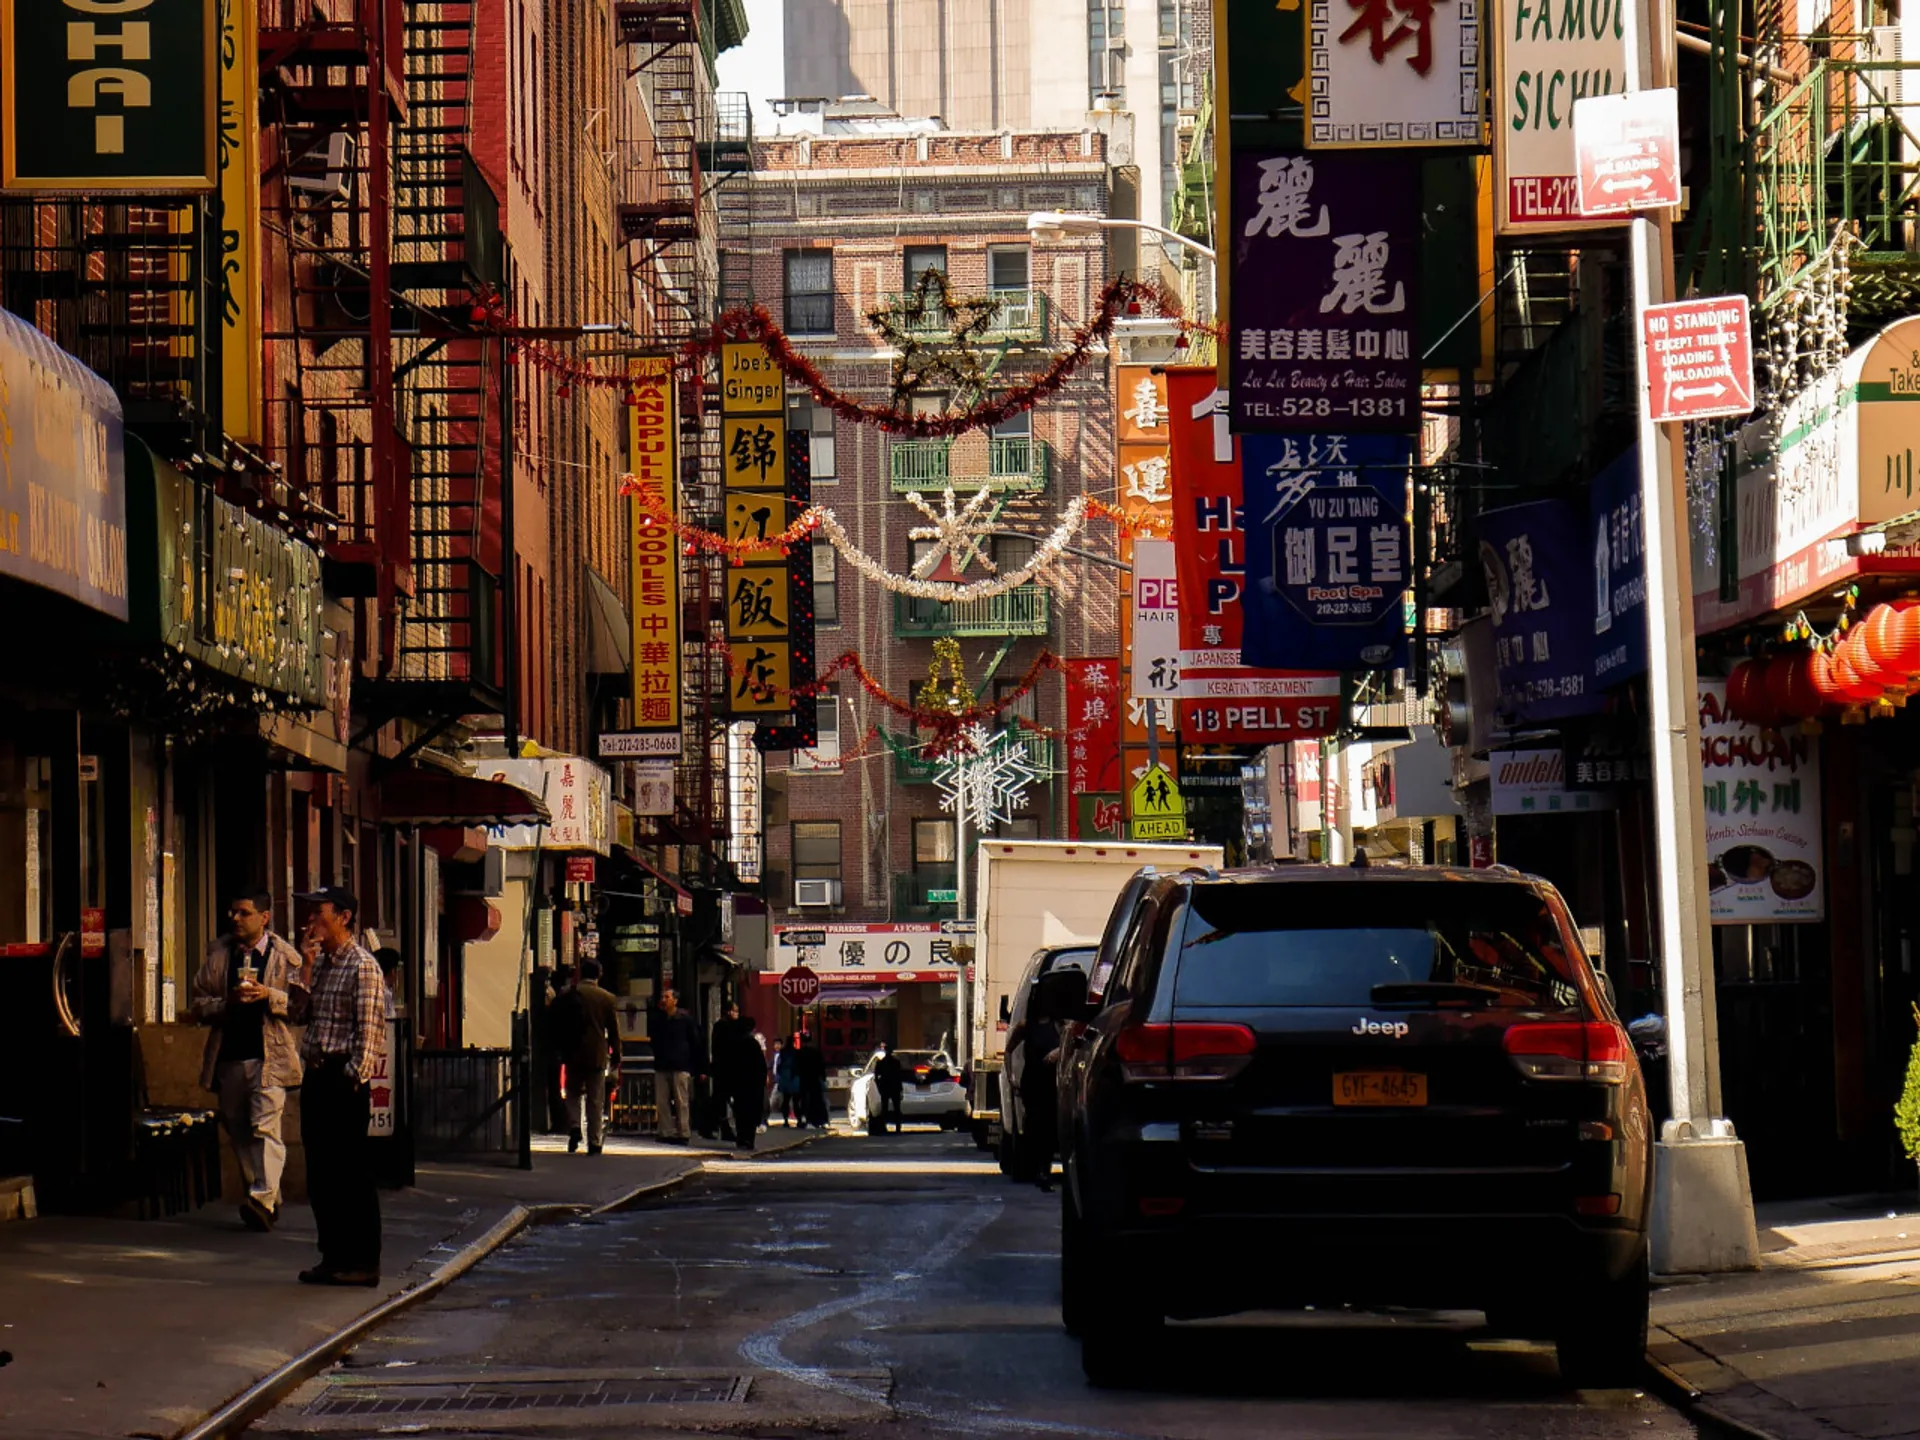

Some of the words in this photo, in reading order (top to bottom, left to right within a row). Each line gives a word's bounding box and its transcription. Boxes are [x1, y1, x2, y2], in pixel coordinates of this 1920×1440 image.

[62, 0, 151, 153] HAI
[1512, 69, 1627, 131] SICH
[1649, 317, 1668, 332] NO
[1674, 309, 1740, 330] STANDING
[1240, 328, 1409, 360] 美容美髮中心
[1655, 336, 1693, 352] EXCEPT
[1697, 332, 1737, 346] TRUCKS
[732, 351, 771, 371] Joe's
[1662, 350, 1714, 368] LOADING
[1242, 369, 1262, 388] Lee
[1265, 369, 1286, 388] Lee
[1291, 369, 1328, 392] Beauty
[1331, 374, 1339, 388] &
[1344, 369, 1370, 388] Hair
[1374, 370, 1408, 388] Salon
[1664, 364, 1732, 382] UNLOADING
[726, 379, 780, 403] Ginger
[1309, 498, 1325, 518] YU
[1329, 498, 1344, 518] ZU
[1348, 497, 1379, 517] TANG
[1285, 524, 1402, 584] 御足堂
[1308, 586, 1346, 601] Foot
[1349, 585, 1384, 601] Spa
[1138, 612, 1175, 622] HAIR
[1190, 652, 1241, 665] JAPANESE
[1207, 681, 1250, 694] KERATIN
[1252, 681, 1313, 694] TREATMENT
[1191, 708, 1220, 732] 18
[1226, 707, 1291, 729] PELL
[1297, 706, 1330, 728] ST
[1138, 821, 1180, 836] AHEAD
[829, 925, 868, 933] PARADISE
[782, 978, 817, 994] STOP
[1352, 1017, 1409, 1039] Jeep
